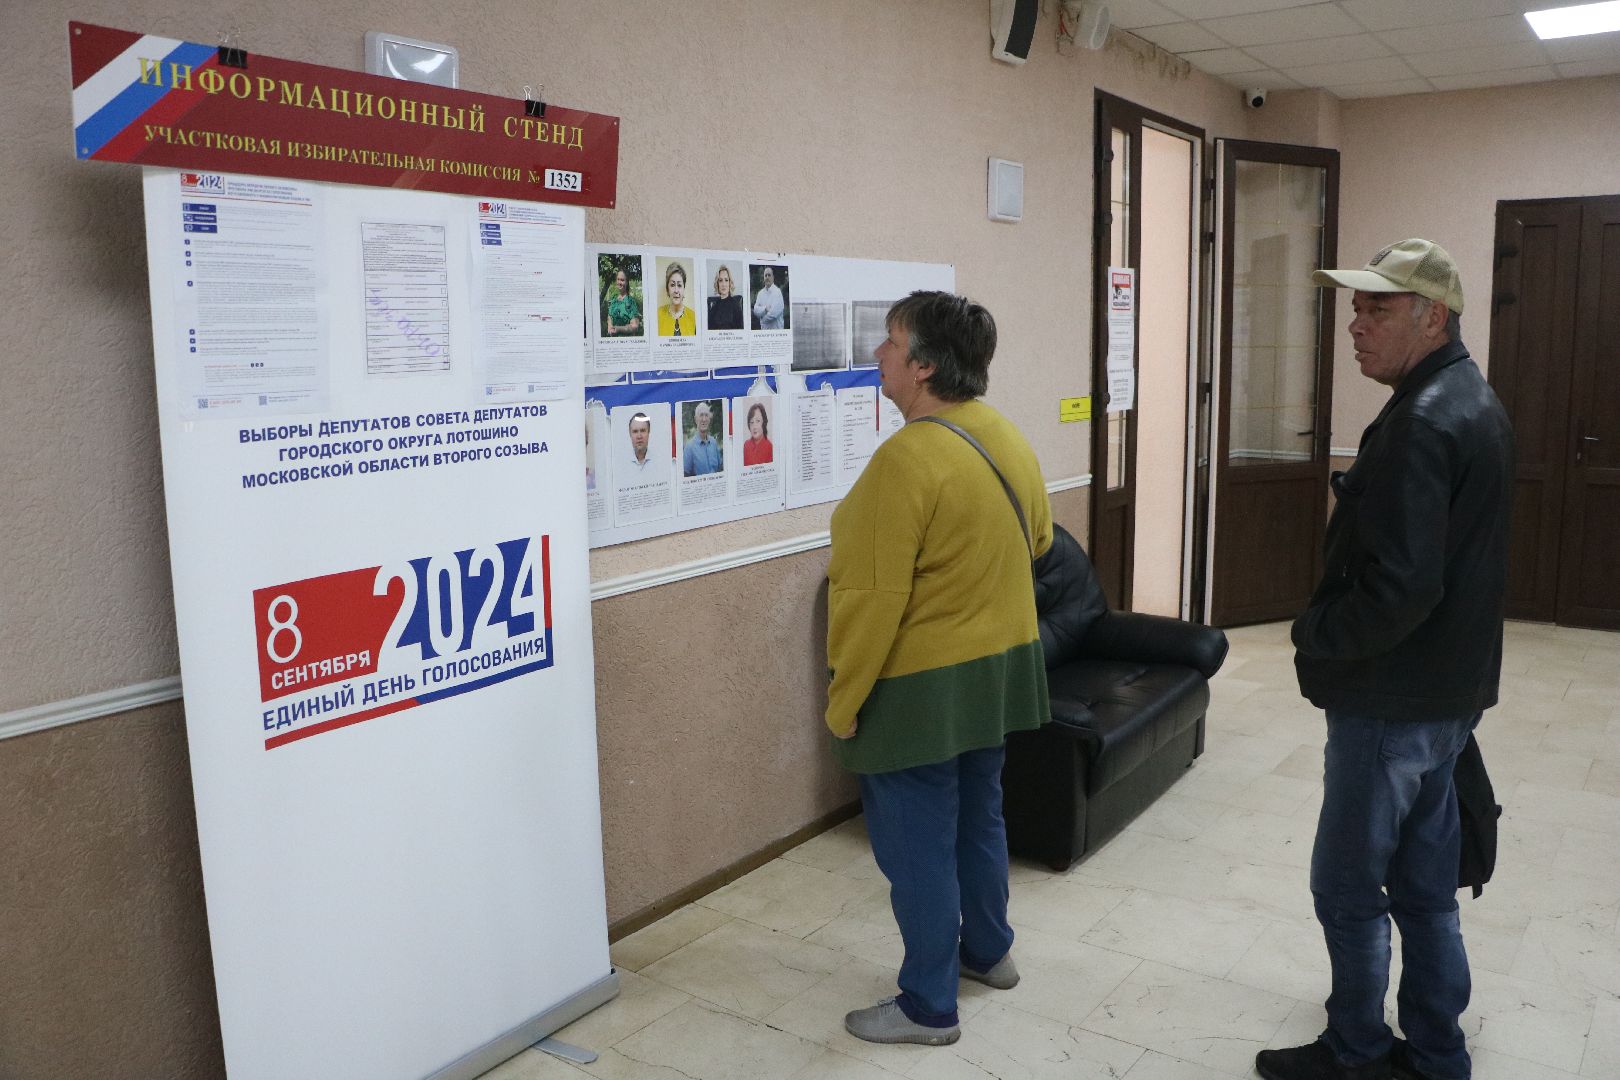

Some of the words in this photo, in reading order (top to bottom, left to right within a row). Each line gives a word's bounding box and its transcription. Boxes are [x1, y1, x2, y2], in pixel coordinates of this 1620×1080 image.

[138, 57, 486, 133] ИНФОРМАЦИОННЫЙ
[503, 116, 584, 151] СТЕНД
[143, 124, 281, 155] УЧАСТКОВАЯ
[287, 142, 435, 172] ИЗБИРАТЕЛЬНАЯ
[440, 160, 521, 182] КОМИССИЯ
[549, 171, 578, 190] 1352
[239, 423, 313, 443] ВЫБОРЫ
[318, 415, 411, 437] ДЕПУТАТОВ
[416, 411, 470, 427] СОВЕТА
[473, 404, 548, 423] ДЕПУТАТОВ
[278, 438, 384, 462] ГОРОДСКОГО
[388, 433, 443, 450] ОКРУГА
[446, 425, 519, 444] ЛОТОШИНО
[242, 460, 353, 489] МОСКОВСКОЙ
[357, 454, 430, 474] ОБЛАСТИ
[433, 447, 492, 466] ВТОРОГО
[494, 441, 549, 458] СОЗЫВА
[266, 594, 303, 664] 8
[372, 536, 543, 673] 2024
[262, 683, 355, 731] ЕДИНЫЙ
[362, 673, 416, 705] ДЕНЬ
[422, 636, 545, 686] ГОЛОСОВАНИЯ
[271, 649, 371, 690] СЕНТЯБРЯ
